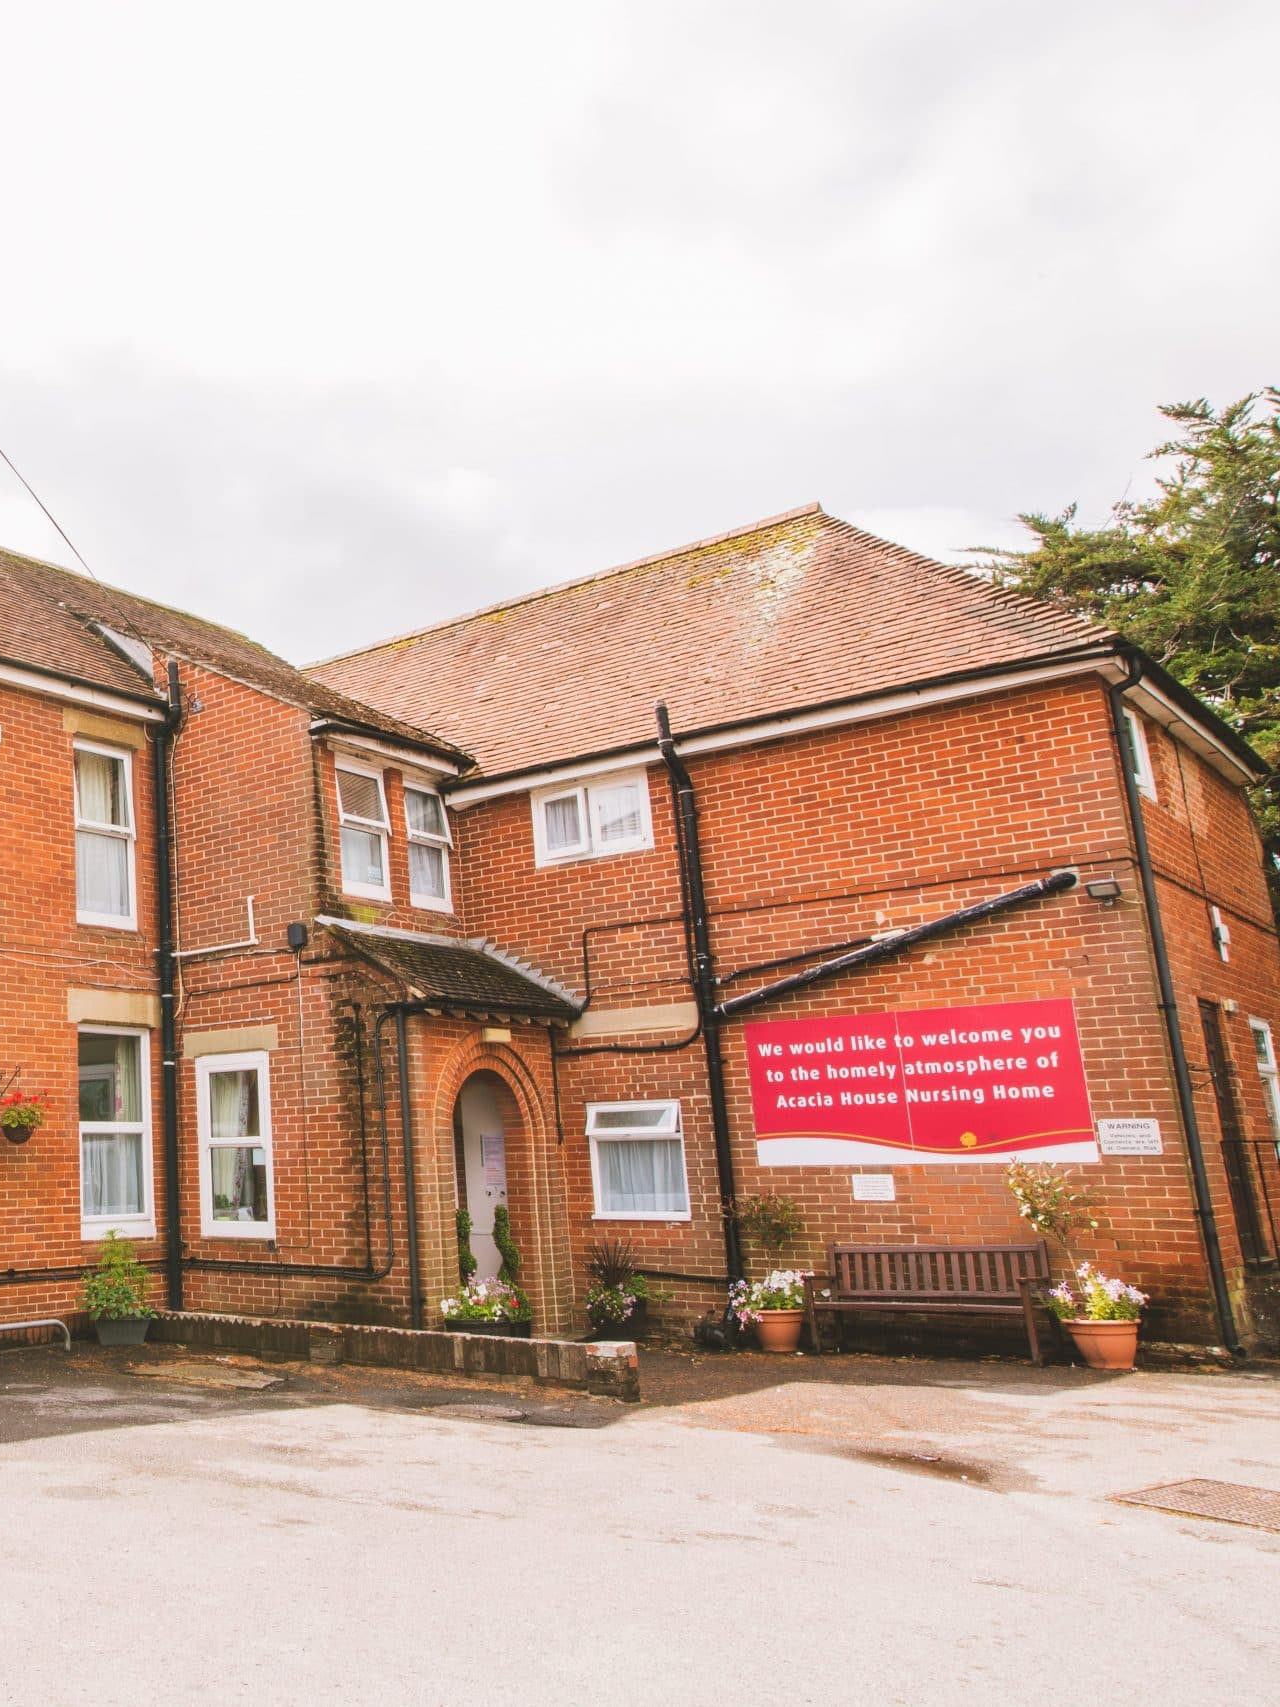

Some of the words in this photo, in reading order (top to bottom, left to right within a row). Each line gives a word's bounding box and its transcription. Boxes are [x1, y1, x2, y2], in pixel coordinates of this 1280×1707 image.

[757, 1043, 783, 1057] We
[789, 1036, 844, 1055] would
[850, 1034, 887, 1051] like
[894, 1033, 914, 1048] to
[921, 1028, 1012, 1046] welcome
[1020, 1025, 1061, 1044] you
[766, 1069, 784, 1083] to
[790, 1066, 820, 1081] the
[826, 1061, 897, 1080] homely
[904, 1055, 1027, 1076] atmosphere
[1036, 1051, 1059, 1069] of
[776, 1092, 833, 1109] Acacia
[840, 1091, 898, 1106] House
[905, 1086, 985, 1104] Nursing
[992, 1084, 1055, 1100] Home
